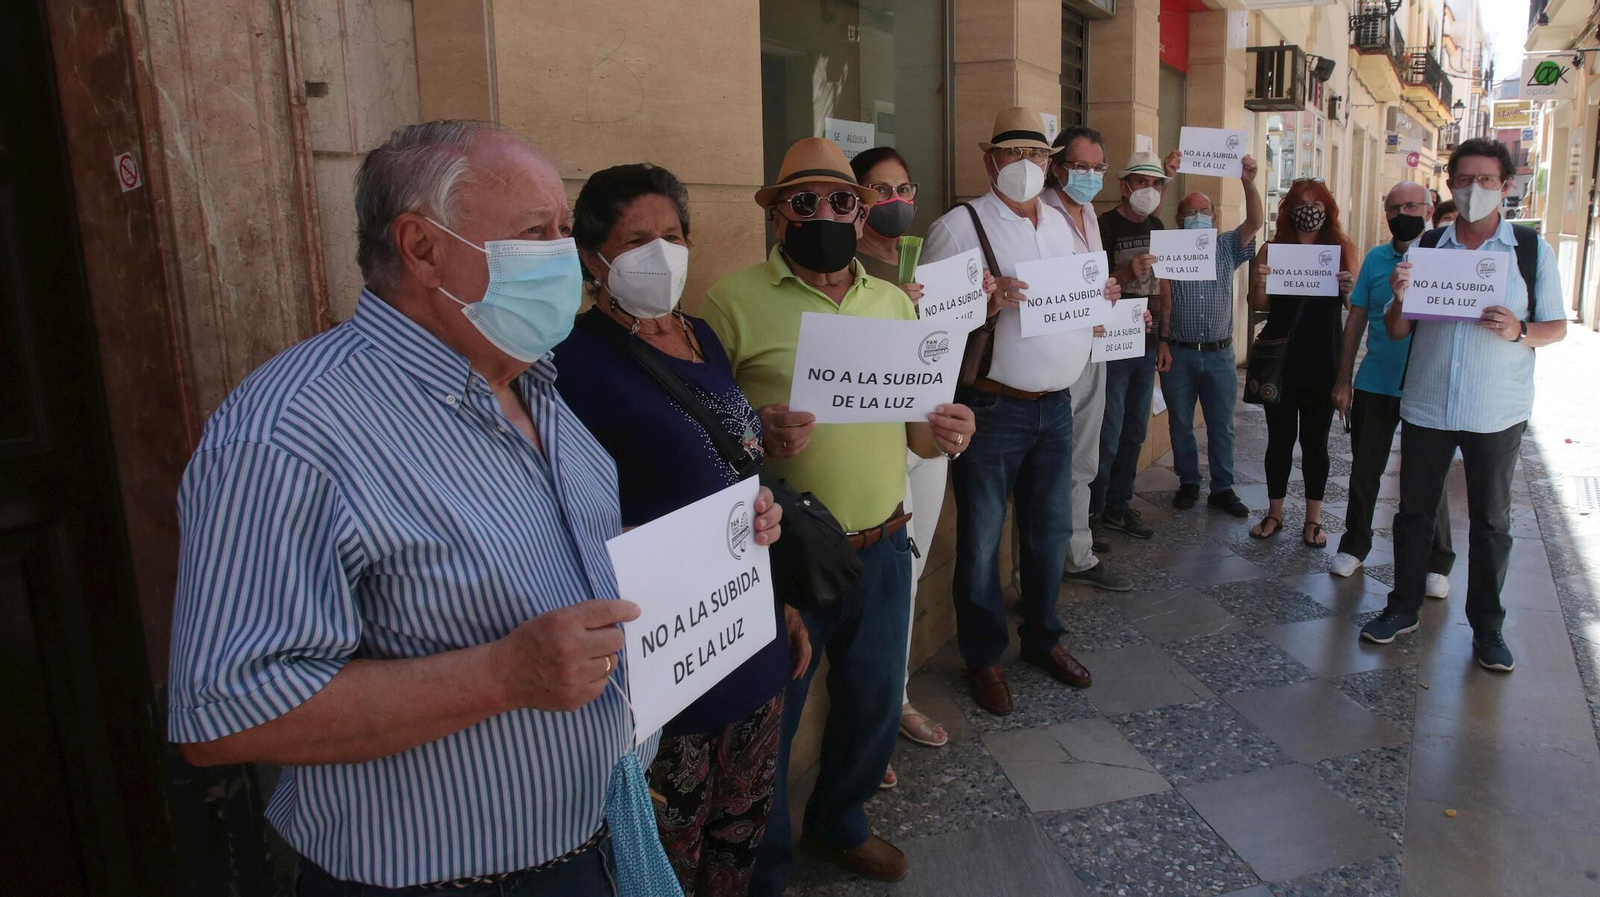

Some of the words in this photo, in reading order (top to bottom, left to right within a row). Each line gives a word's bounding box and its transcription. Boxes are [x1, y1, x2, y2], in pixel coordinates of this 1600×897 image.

[1527, 61, 1570, 86] LOOK
[834, 132, 840, 141] SE
[846, 134, 867, 144] ALQUILA
[1413, 280, 1428, 288] NO
[1456, 282, 1494, 292] SUBIDA
[925, 304, 937, 317] NO
[939, 302, 945, 312] A
[947, 299, 956, 309] LA
[958, 289, 983, 306] SUBIDA
[1028, 298, 1042, 307] NO
[1045, 296, 1053, 305] A
[1055, 294, 1066, 304] LA
[1069, 288, 1102, 302] SUBIDA
[1427, 296, 1440, 304] DE
[1458, 298, 1476, 307] LUZ
[1044, 313, 1056, 323] DE
[1060, 311, 1071, 320] LA
[1074, 308, 1090, 318] LUZ
[1122, 327, 1141, 336] SUBIDA
[808, 368, 835, 382] NO
[840, 371, 852, 383] A
[858, 372, 878, 384] LA
[883, 372, 943, 385] SUBIDA
[832, 394, 854, 408] DE
[860, 397, 879, 408] LA
[884, 397, 915, 408] LUZ
[641, 624, 668, 658] NO
[674, 614, 686, 639] A
[690, 600, 709, 628] LA
[711, 566, 760, 613] SUBIDA
[673, 653, 695, 685] DE
[699, 639, 716, 668] LA
[720, 618, 745, 652] LUZ
